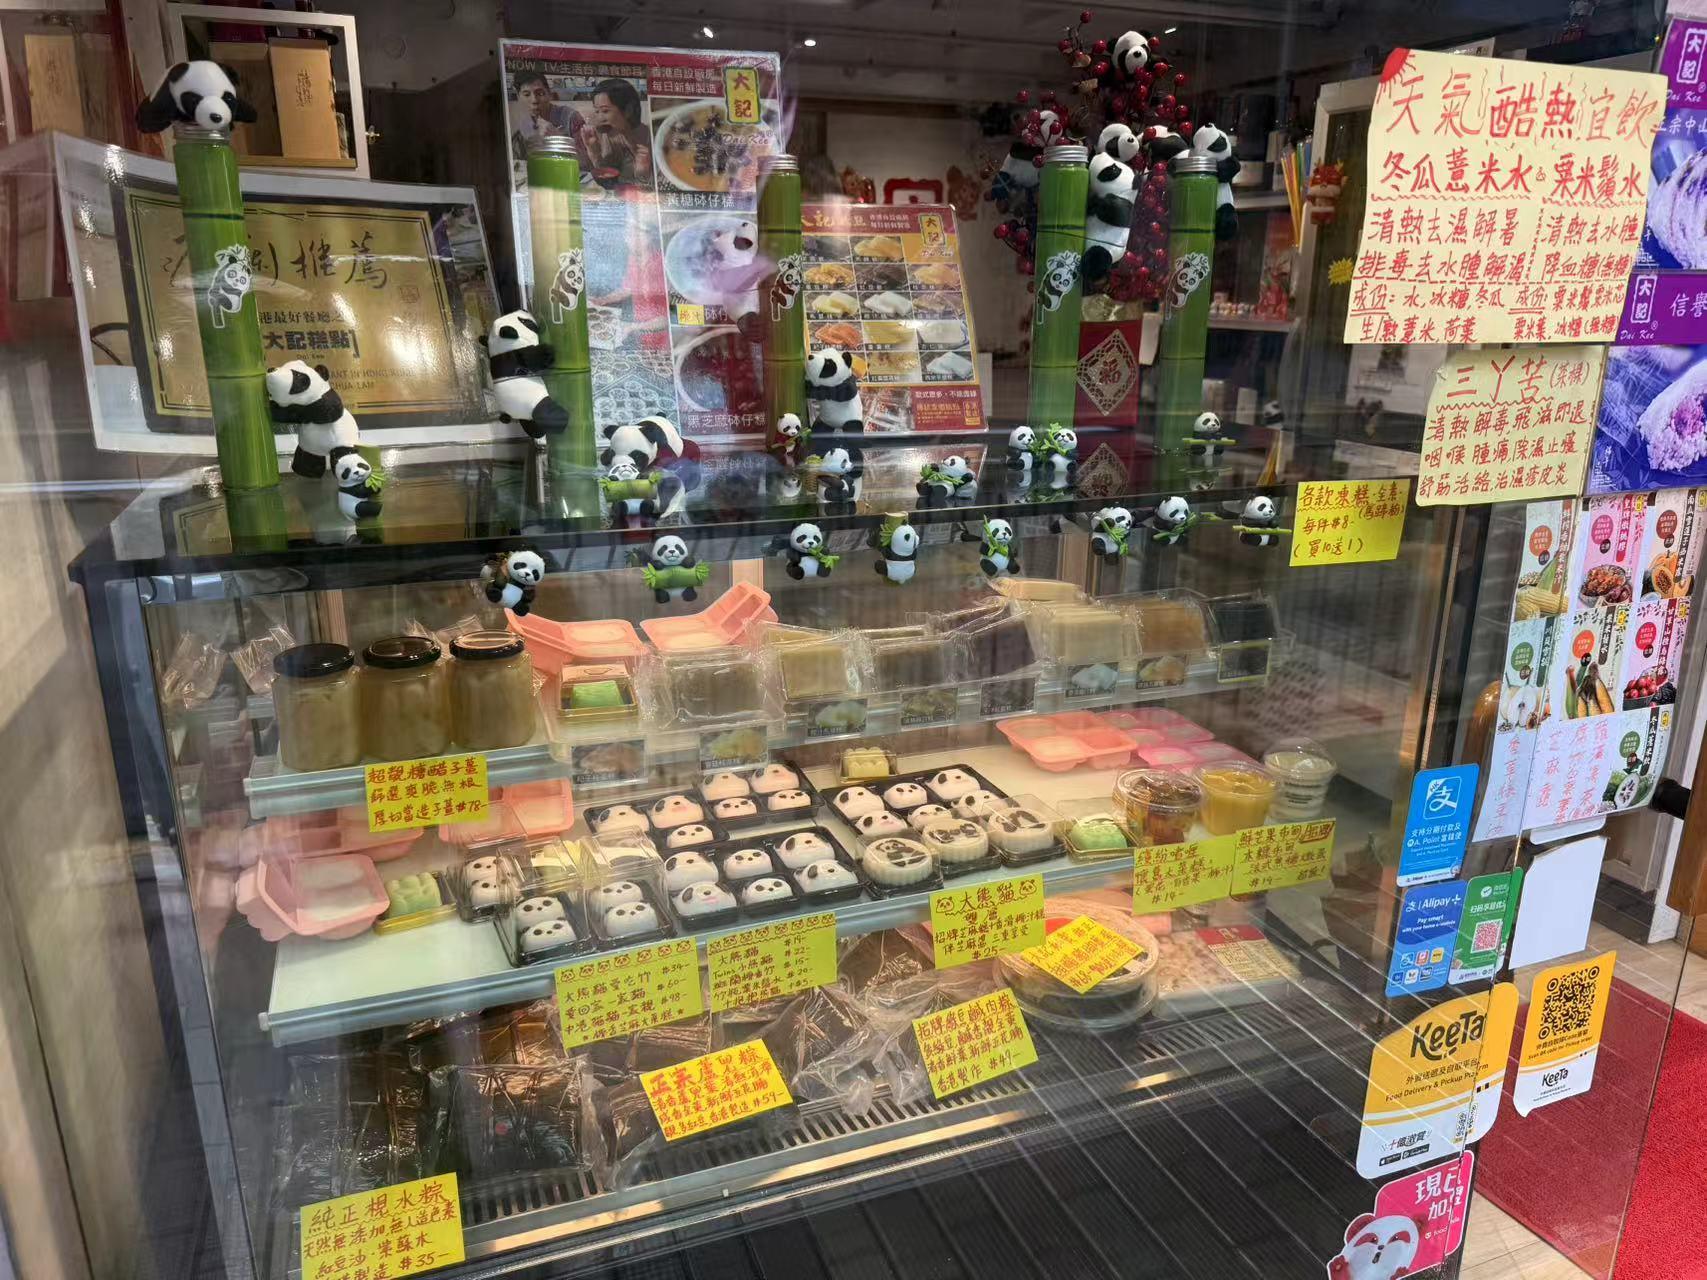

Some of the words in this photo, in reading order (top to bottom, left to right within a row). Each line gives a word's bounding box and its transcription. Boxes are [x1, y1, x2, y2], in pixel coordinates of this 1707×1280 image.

[507, 60, 536, 71] NOW
[1681, 34, 1702, 79] 大記
[652, 81, 717, 94] 每日新鮮製造
[733, 70, 752, 119] 大記
[1386, 67, 1659, 149] 天氣酷熱宜飲
[722, 133, 745, 146] Dai
[1380, 146, 1534, 194] 冬瓜薏米水
[1368, 205, 1520, 247] 清熱去濕解暑
[1541, 211, 1640, 247] 清熱去水腫
[1359, 248, 1527, 282] 排毒去水腫解渴
[1635, 282, 1652, 319] 大記
[959, 882, 1015, 911] 大熊貓
[1417, 916, 1428, 925] Pay
[1410, 1009, 1487, 1061] KeeTa
[1385, 1091, 1403, 1102] Food
[1403, 1083, 1432, 1098] Delivery
[1440, 1074, 1463, 1089] Pickup
[1541, 1067, 1569, 1087] KeeTa
